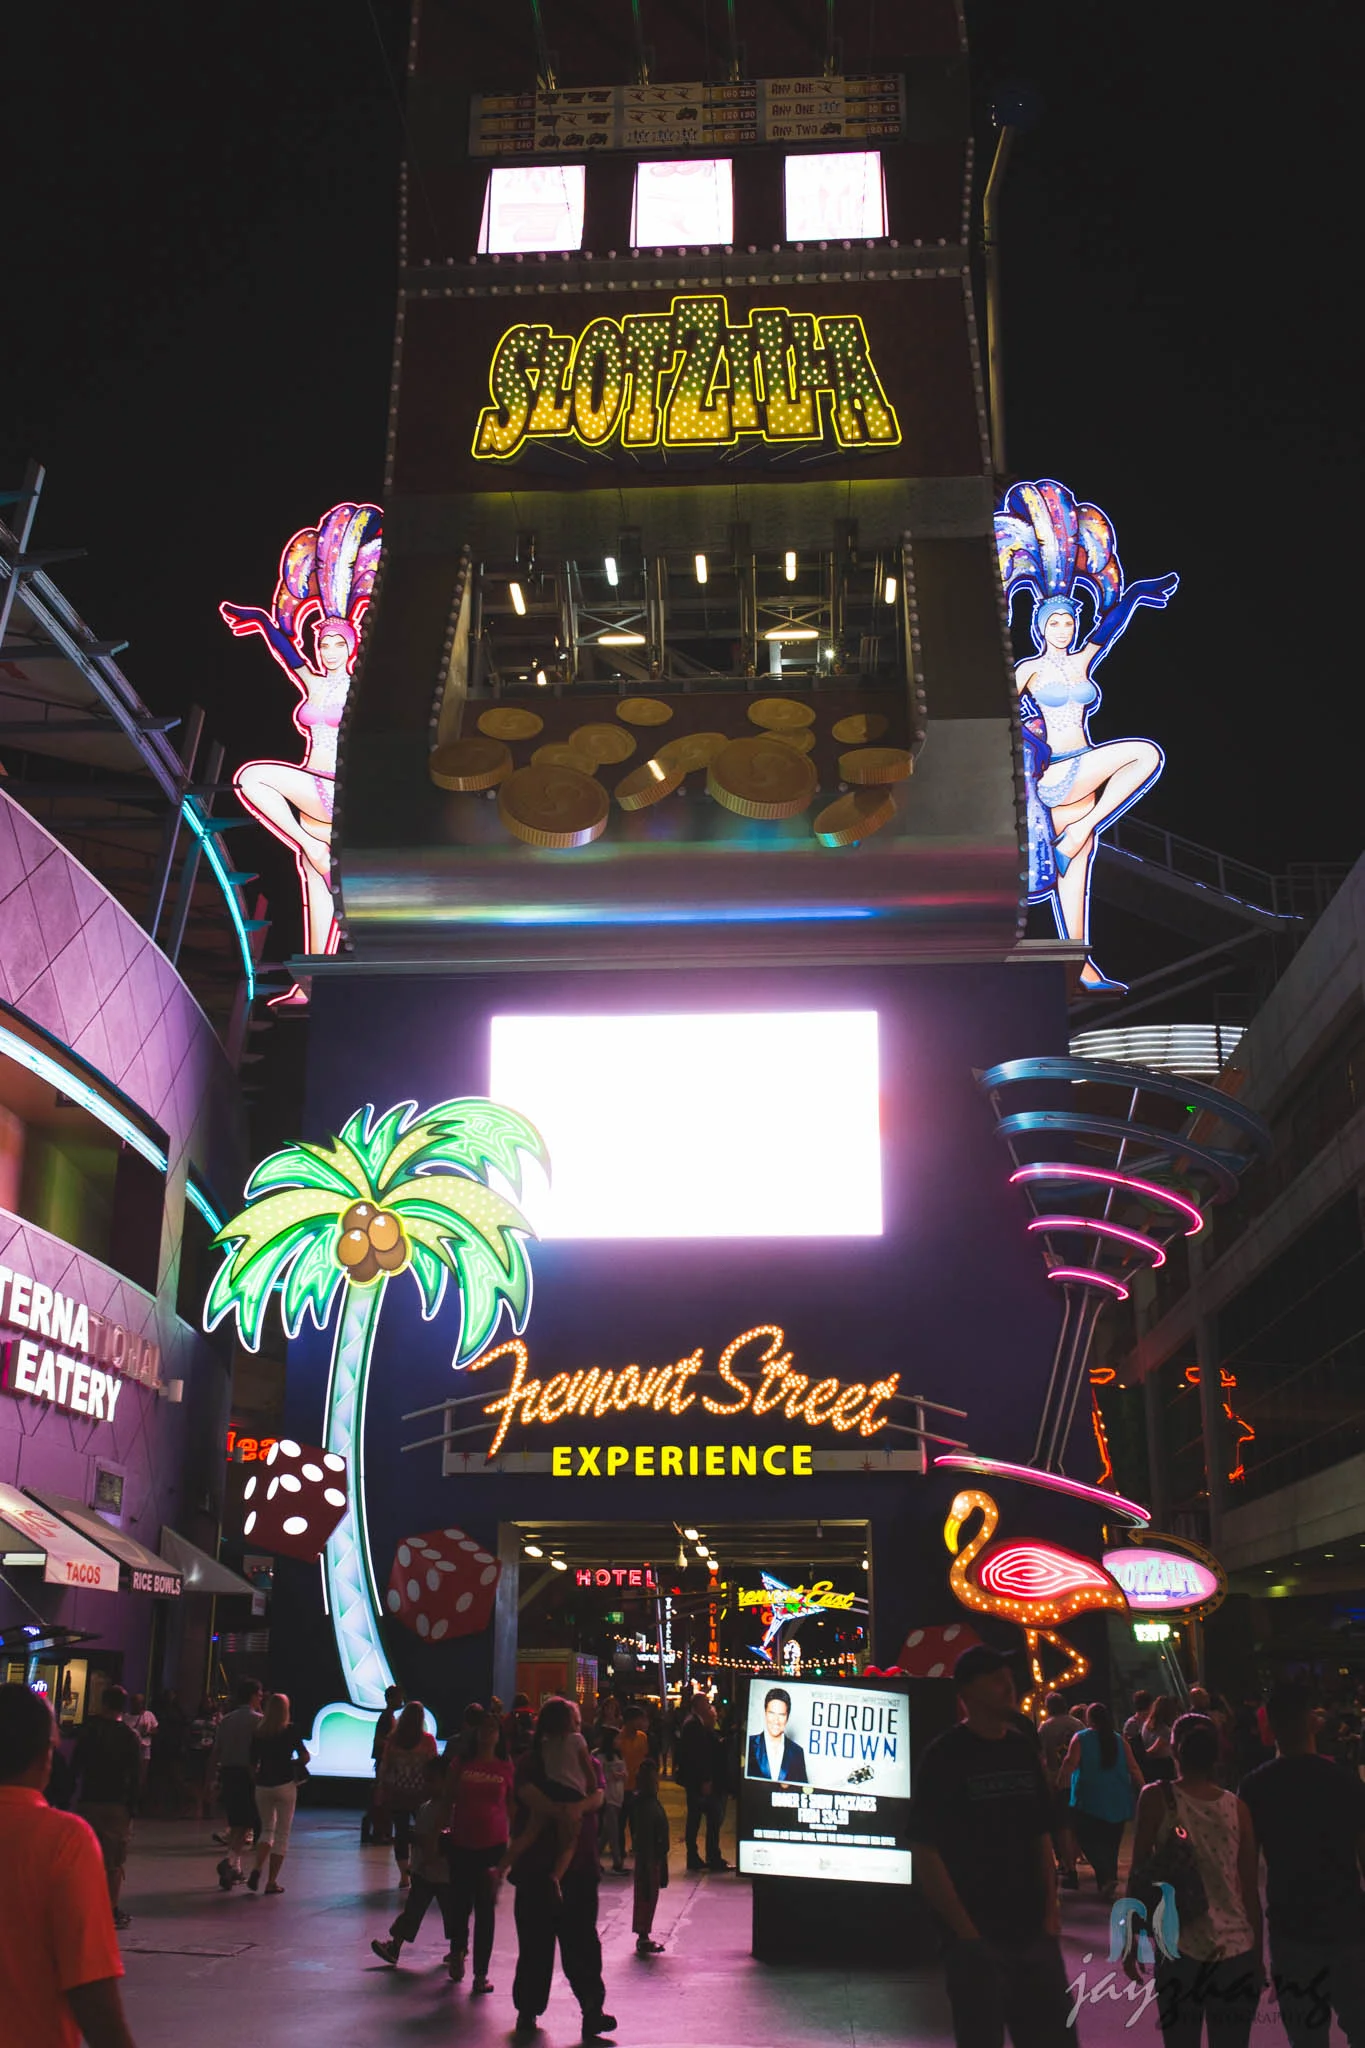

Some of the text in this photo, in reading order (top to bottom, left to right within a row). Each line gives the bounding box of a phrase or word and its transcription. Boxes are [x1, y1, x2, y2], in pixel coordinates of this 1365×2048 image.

[771, 81, 816, 95] ANY ONE
[772, 103, 816, 116] ANY ONE
[772, 123, 817, 137] ANY TWO
[471, 294, 903, 460] SLOTZILLA
[14, 1340, 122, 1423] EATERY
[465, 1324, 902, 1465] Fremont Street
[552, 1444, 814, 1478] EXPERIENCE
[66, 1561, 101, 1586] TACOS
[132, 1571, 182, 1596] RICE BOWLS
[576, 1568, 657, 1590] HOTEL
[805, 1580, 856, 1610] East
[811, 1701, 899, 1736] GORDIE
[808, 1730, 898, 1763] BROWN
